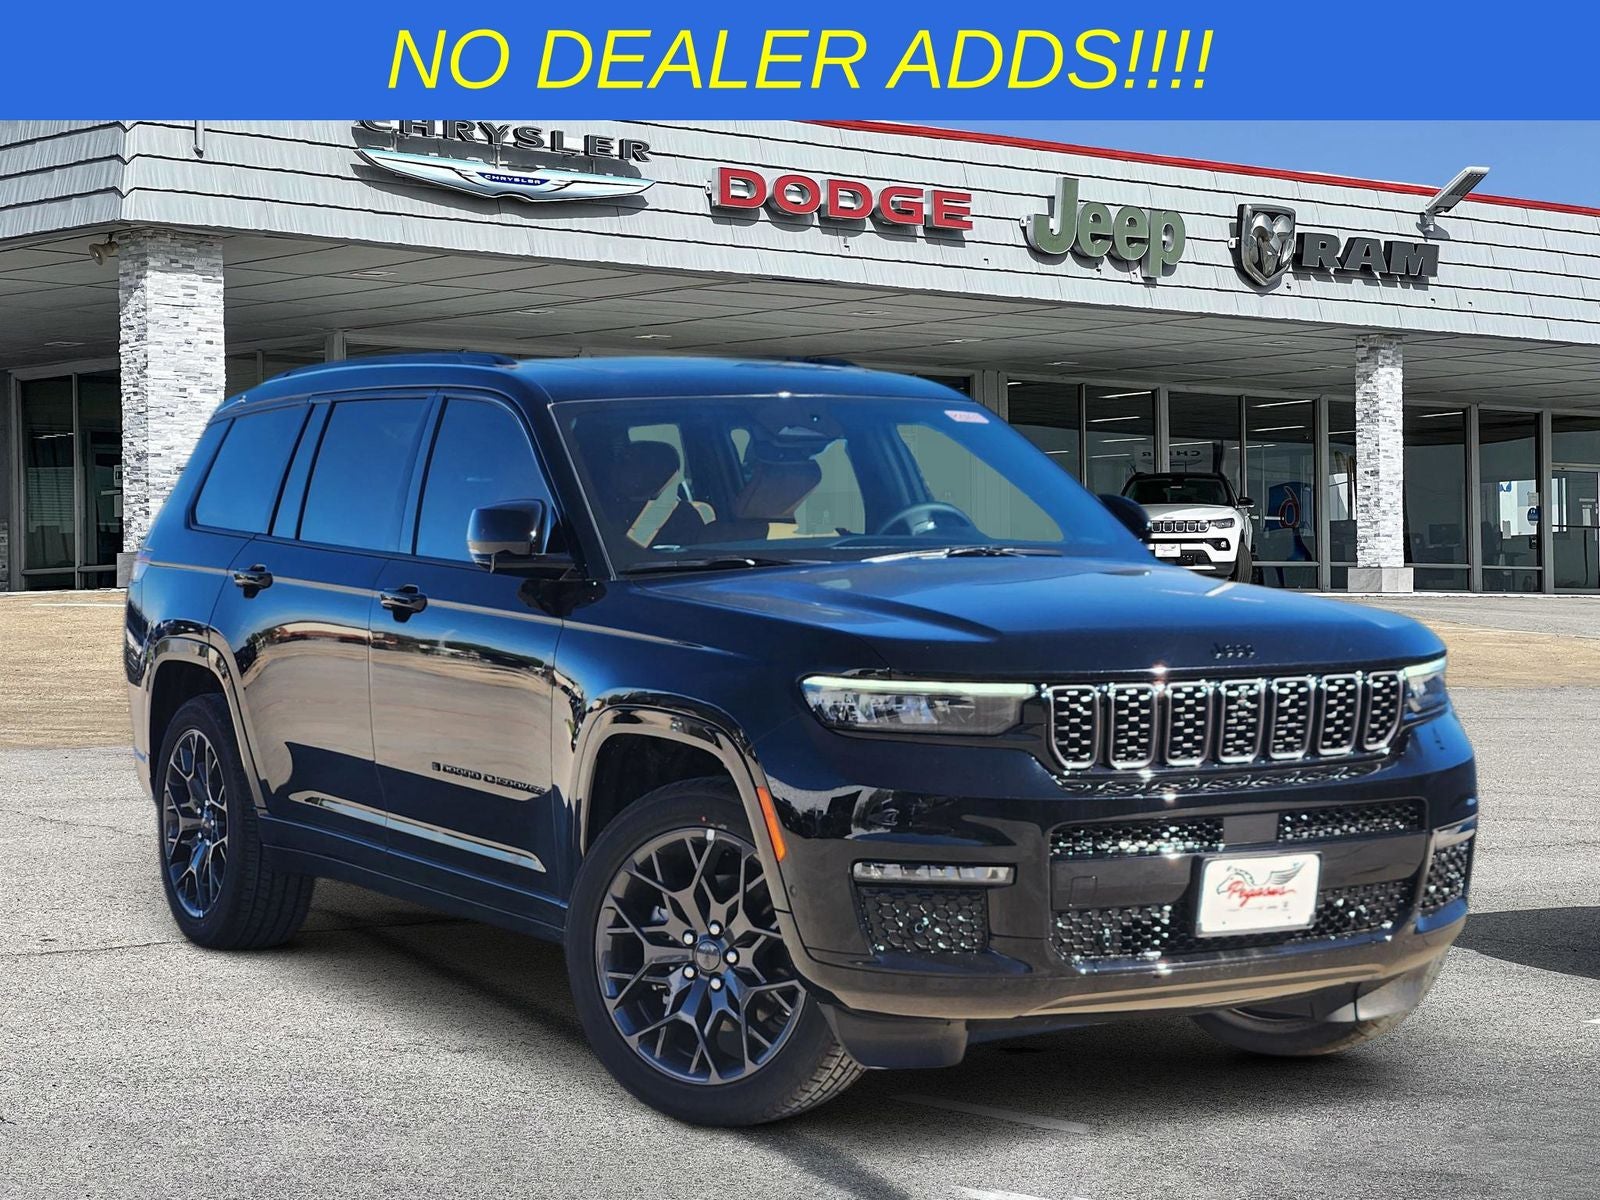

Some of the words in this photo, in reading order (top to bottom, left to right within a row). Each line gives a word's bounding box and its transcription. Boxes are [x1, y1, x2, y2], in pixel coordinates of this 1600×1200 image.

[483, 174, 541, 185] CHRYSLER
[712, 166, 974, 230] DODGE
[1028, 177, 1187, 278] Jeep
[1300, 232, 1440, 277] RAM
